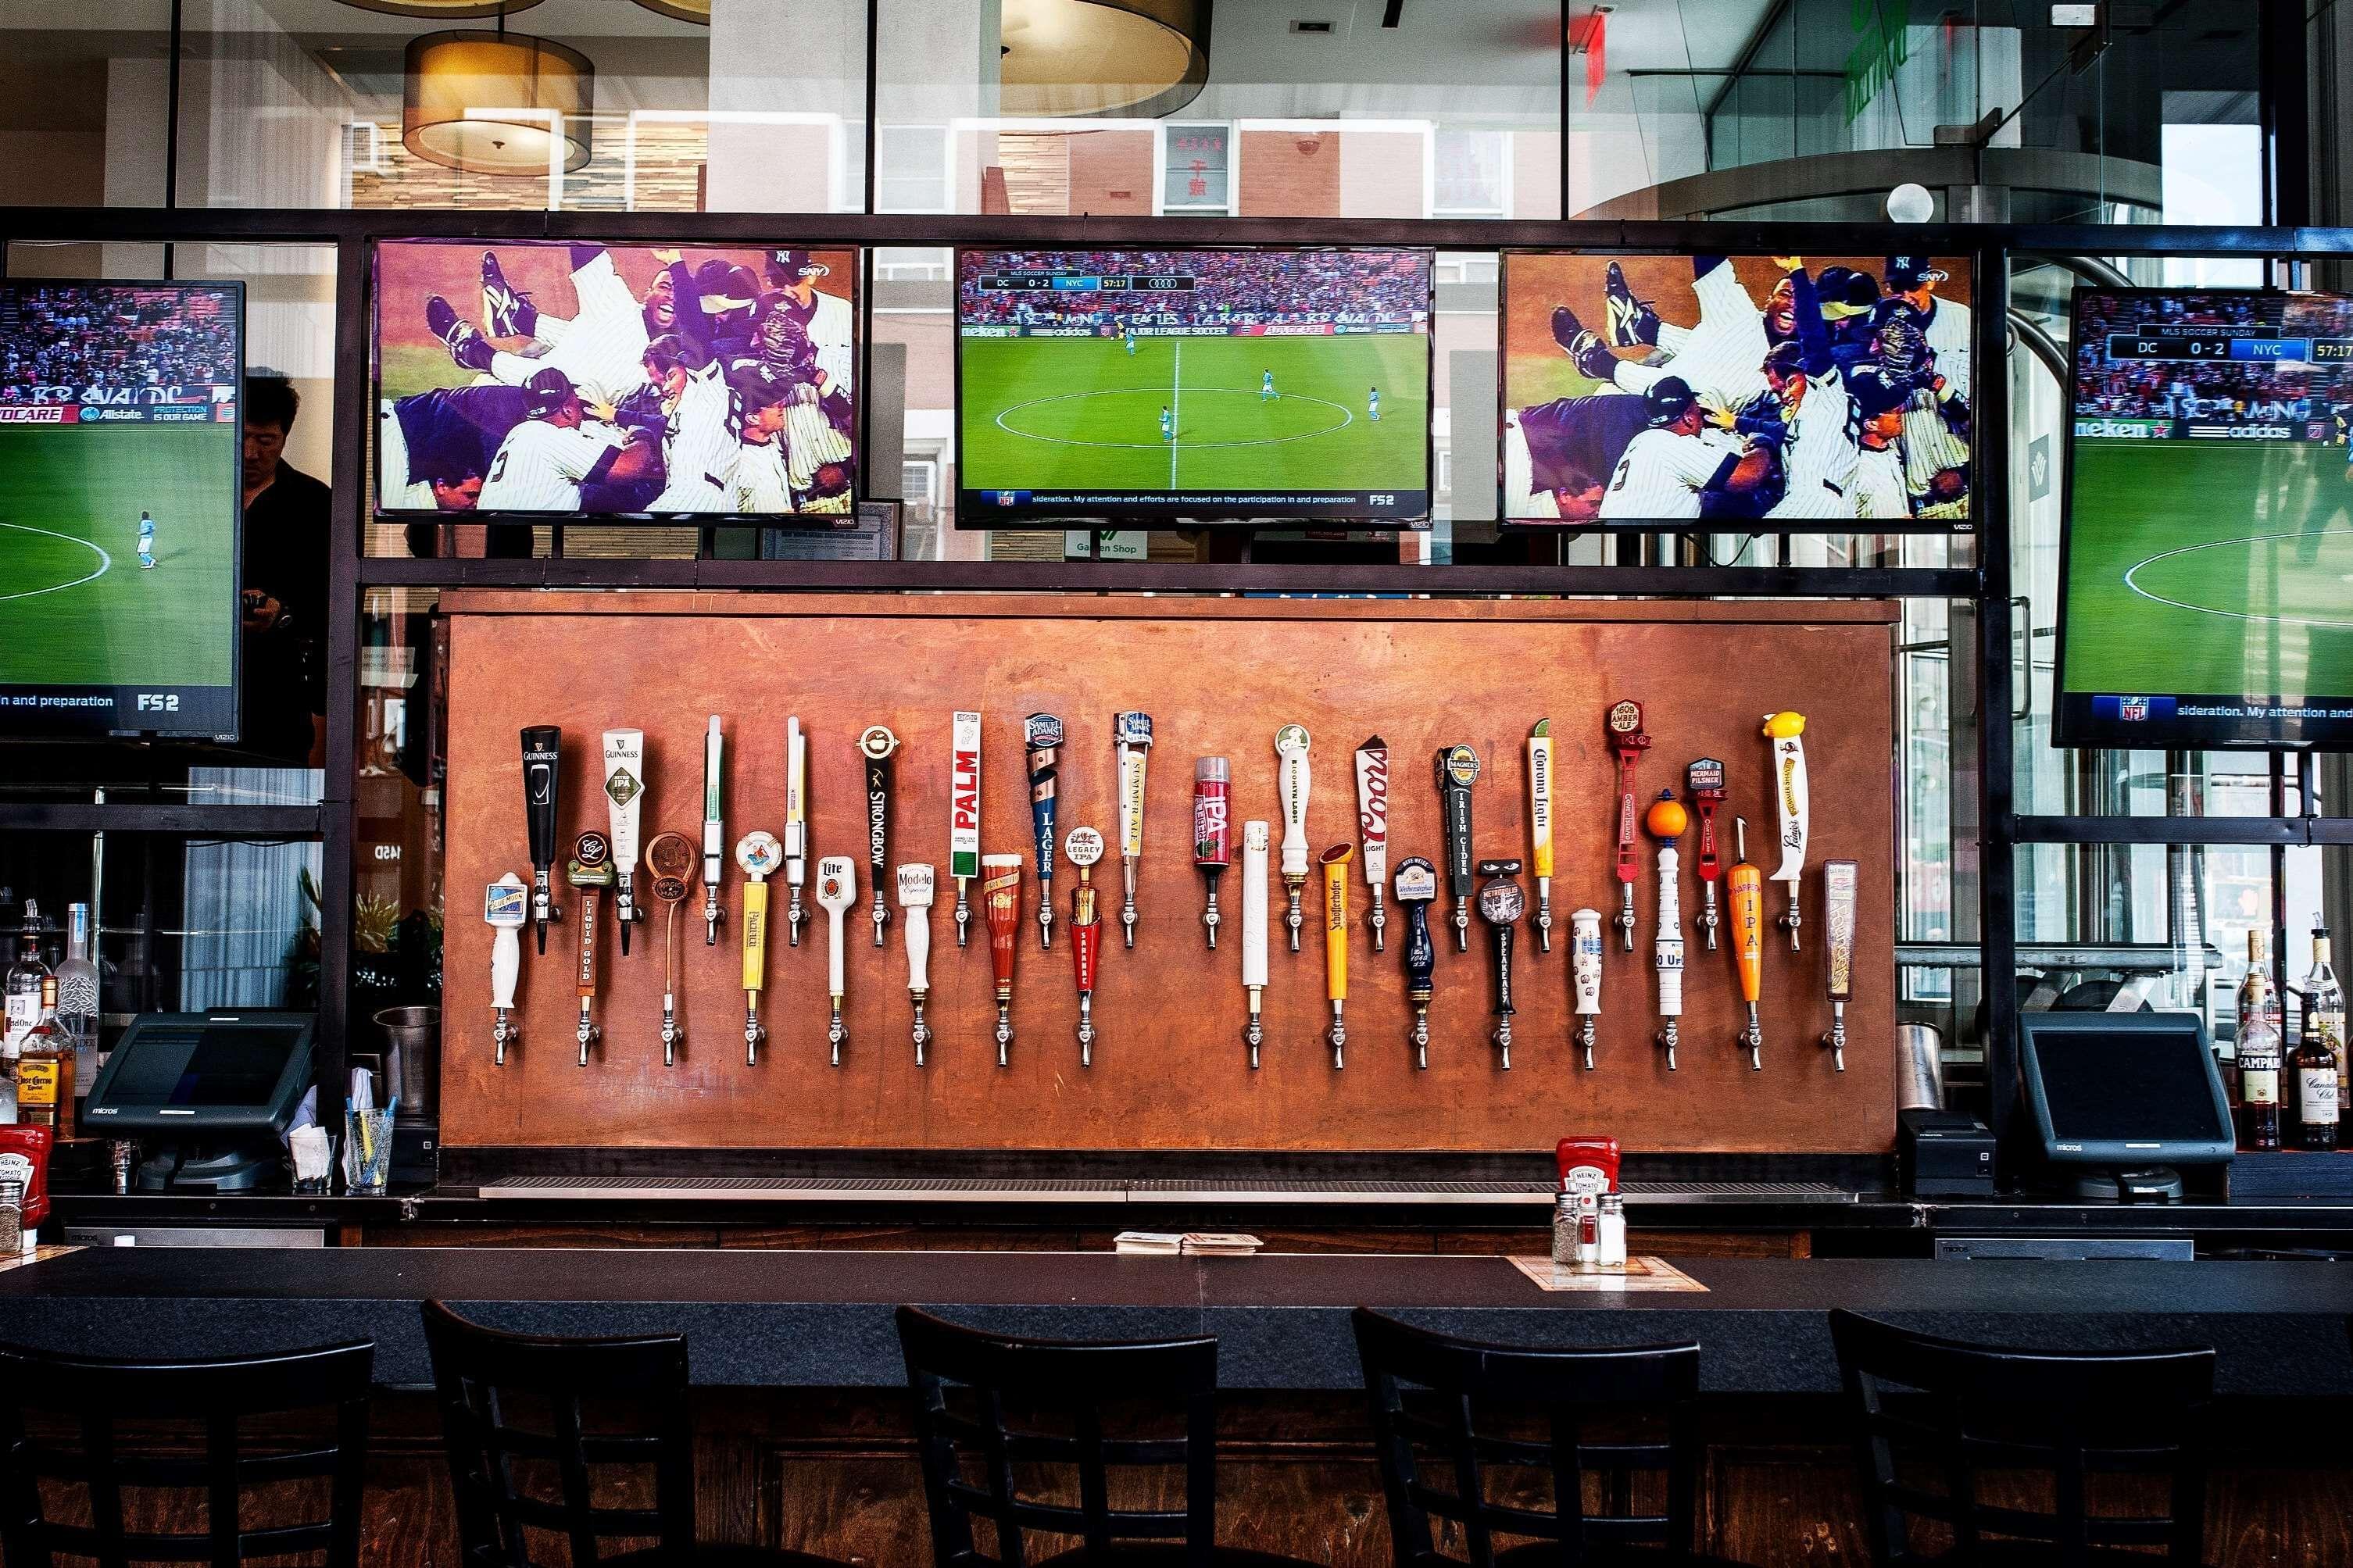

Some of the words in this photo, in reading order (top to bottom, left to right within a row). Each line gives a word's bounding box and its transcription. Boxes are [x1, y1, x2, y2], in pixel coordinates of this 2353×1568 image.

[797, 264, 830, 277] SNY
[1916, 270, 1949, 282] SNY
[996, 278, 1010, 287] DC
[1065, 279, 1084, 288] NYC
[1103, 280, 1126, 288] 57:17
[1053, 327, 1092, 337] adidas
[2182, 328, 2219, 337] SOCCER
[2220, 329, 2256, 338] SUNDAY
[2138, 342, 2158, 354] DC
[2191, 343, 2202, 354] 0
[2214, 344, 2225, 355] 2
[2252, 345, 2282, 356] NYC
[2317, 345, 2352, 357] 57:17
[99, 408, 144, 420] Allstate
[2230, 423, 2291, 440] adidas
[999, 497, 1014, 506] NFL
[1074, 496, 1085, 505] My
[1238, 496, 1286, 505] participation
[1312, 496, 1357, 505] preparation
[1369, 495, 1394, 505] FS2
[1077, 543, 1110, 552] Gaen
[1114, 545, 1137, 554] Shop
[13, 695, 36, 706] and
[40, 695, 113, 708] preparation
[138, 694, 179, 712] FS2
[1616, 705, 1635, 715] 1609
[2122, 707, 2145, 720] NFL
[2177, 706, 2244, 717] sideration.
[2247, 707, 2266, 719] My
[2269, 707, 2326, 718] attention
[2329, 708, 2352, 719] and
[1029, 720, 1060, 730] SAMUEL
[1611, 714, 1639, 723] AMBER
[1032, 727, 1060, 737] ADAMS
[524, 752, 558, 761] GUINNESS
[1532, 748, 1547, 795] Corona
[954, 750, 978, 830] PALM
[1362, 748, 1388, 845] Coors
[1625, 793, 1633, 816] CONEY
[1203, 796, 1228, 834] IPA
[1458, 792, 1467, 832] IRISH
[1535, 797, 1549, 828] Light
[870, 791, 885, 868] STRONGBOW
[1196, 805, 1207, 841] REBEL
[1042, 813, 1053, 873] LAGER
[1460, 837, 1468, 876] CIDER
[821, 862, 842, 877] Lite
[899, 873, 932, 886] Modelo
[902, 885, 928, 895] Especial
[1483, 886, 1518, 898] METROPOLIS
[489, 897, 506, 909] BLUE
[505, 893, 524, 904] MOON
[583, 900, 593, 945] LIQUID
[1746, 899, 1758, 946] IPA
[582, 950, 591, 980] GOLD
[18, 1075, 32, 1085] Jose
[32, 1075, 52, 1086] Cuervo
[1576, 1171, 1597, 1180] HEINZ
